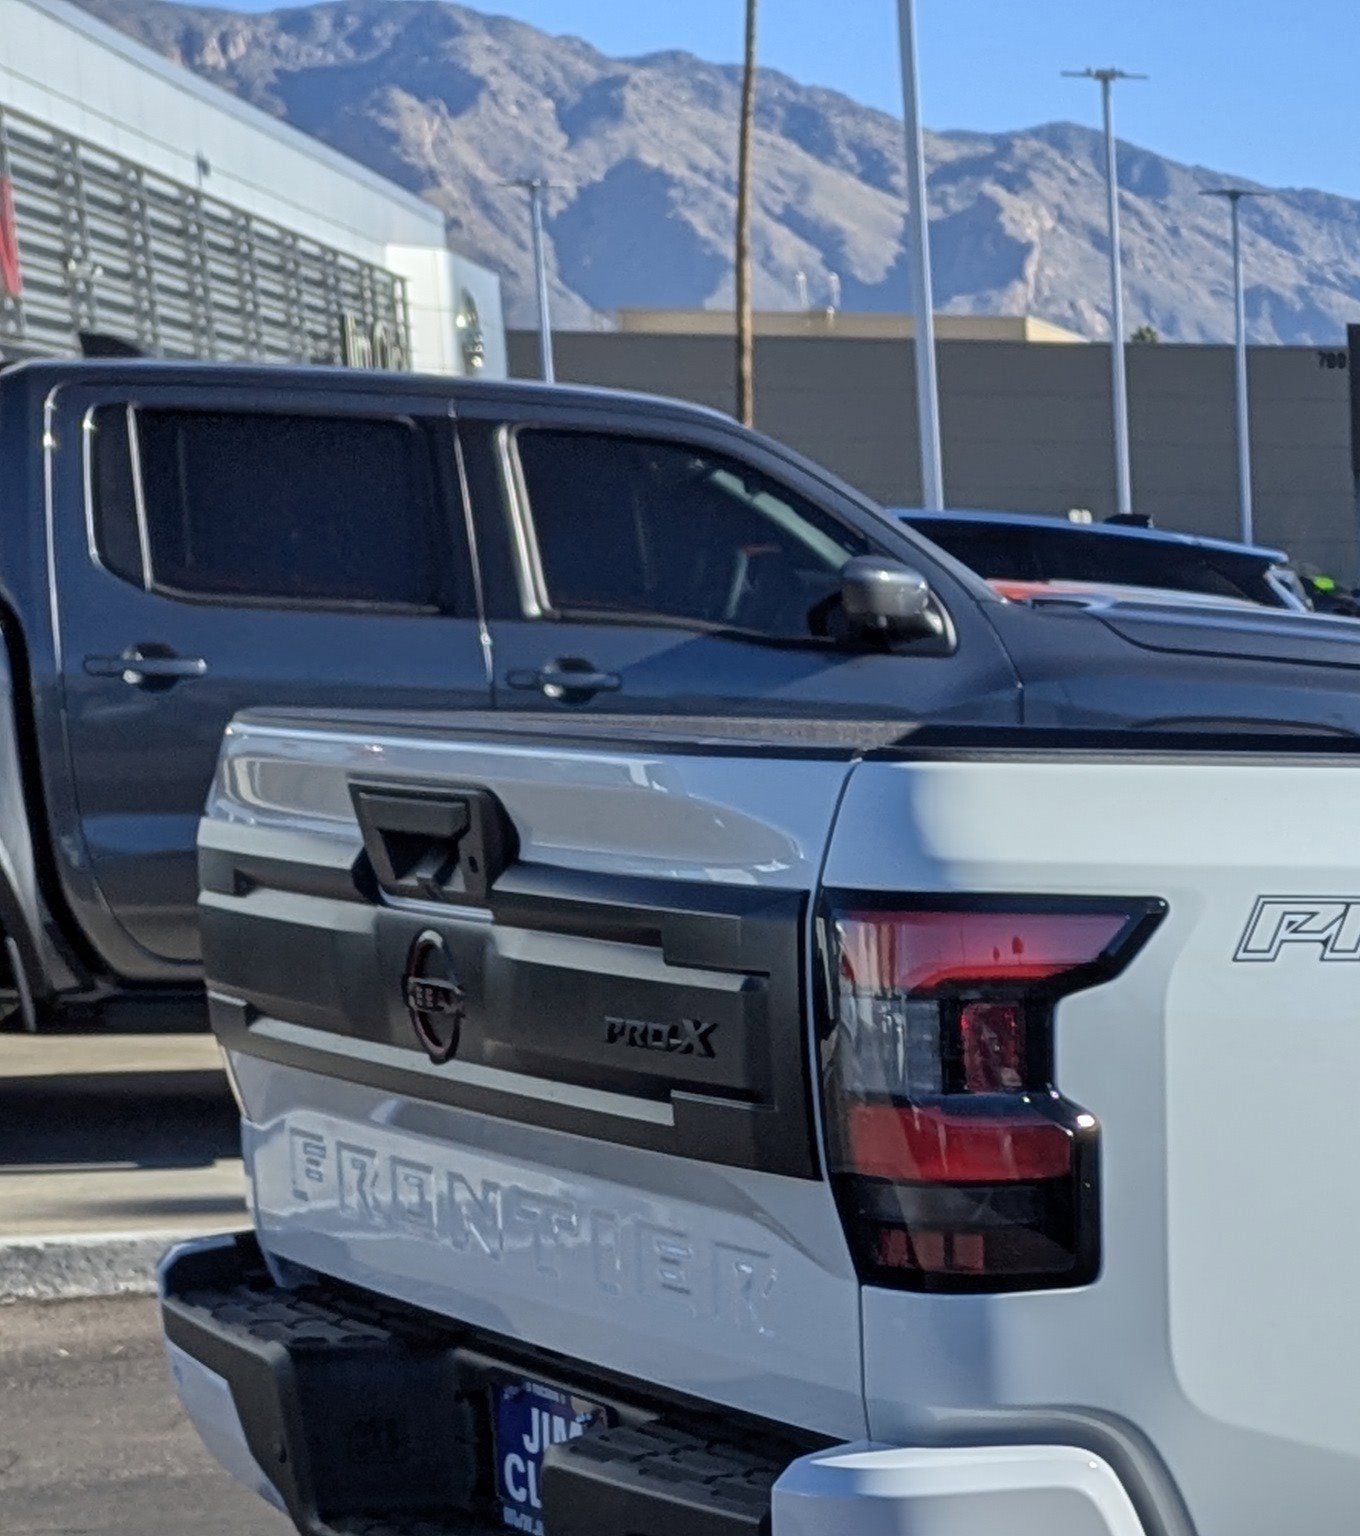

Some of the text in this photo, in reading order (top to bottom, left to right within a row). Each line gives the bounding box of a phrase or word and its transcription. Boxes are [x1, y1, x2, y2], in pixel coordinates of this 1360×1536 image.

[289, 1127, 779, 1338] FRONTIER
[522, 1407, 583, 1454] JIM
[504, 1453, 543, 1508] CL
